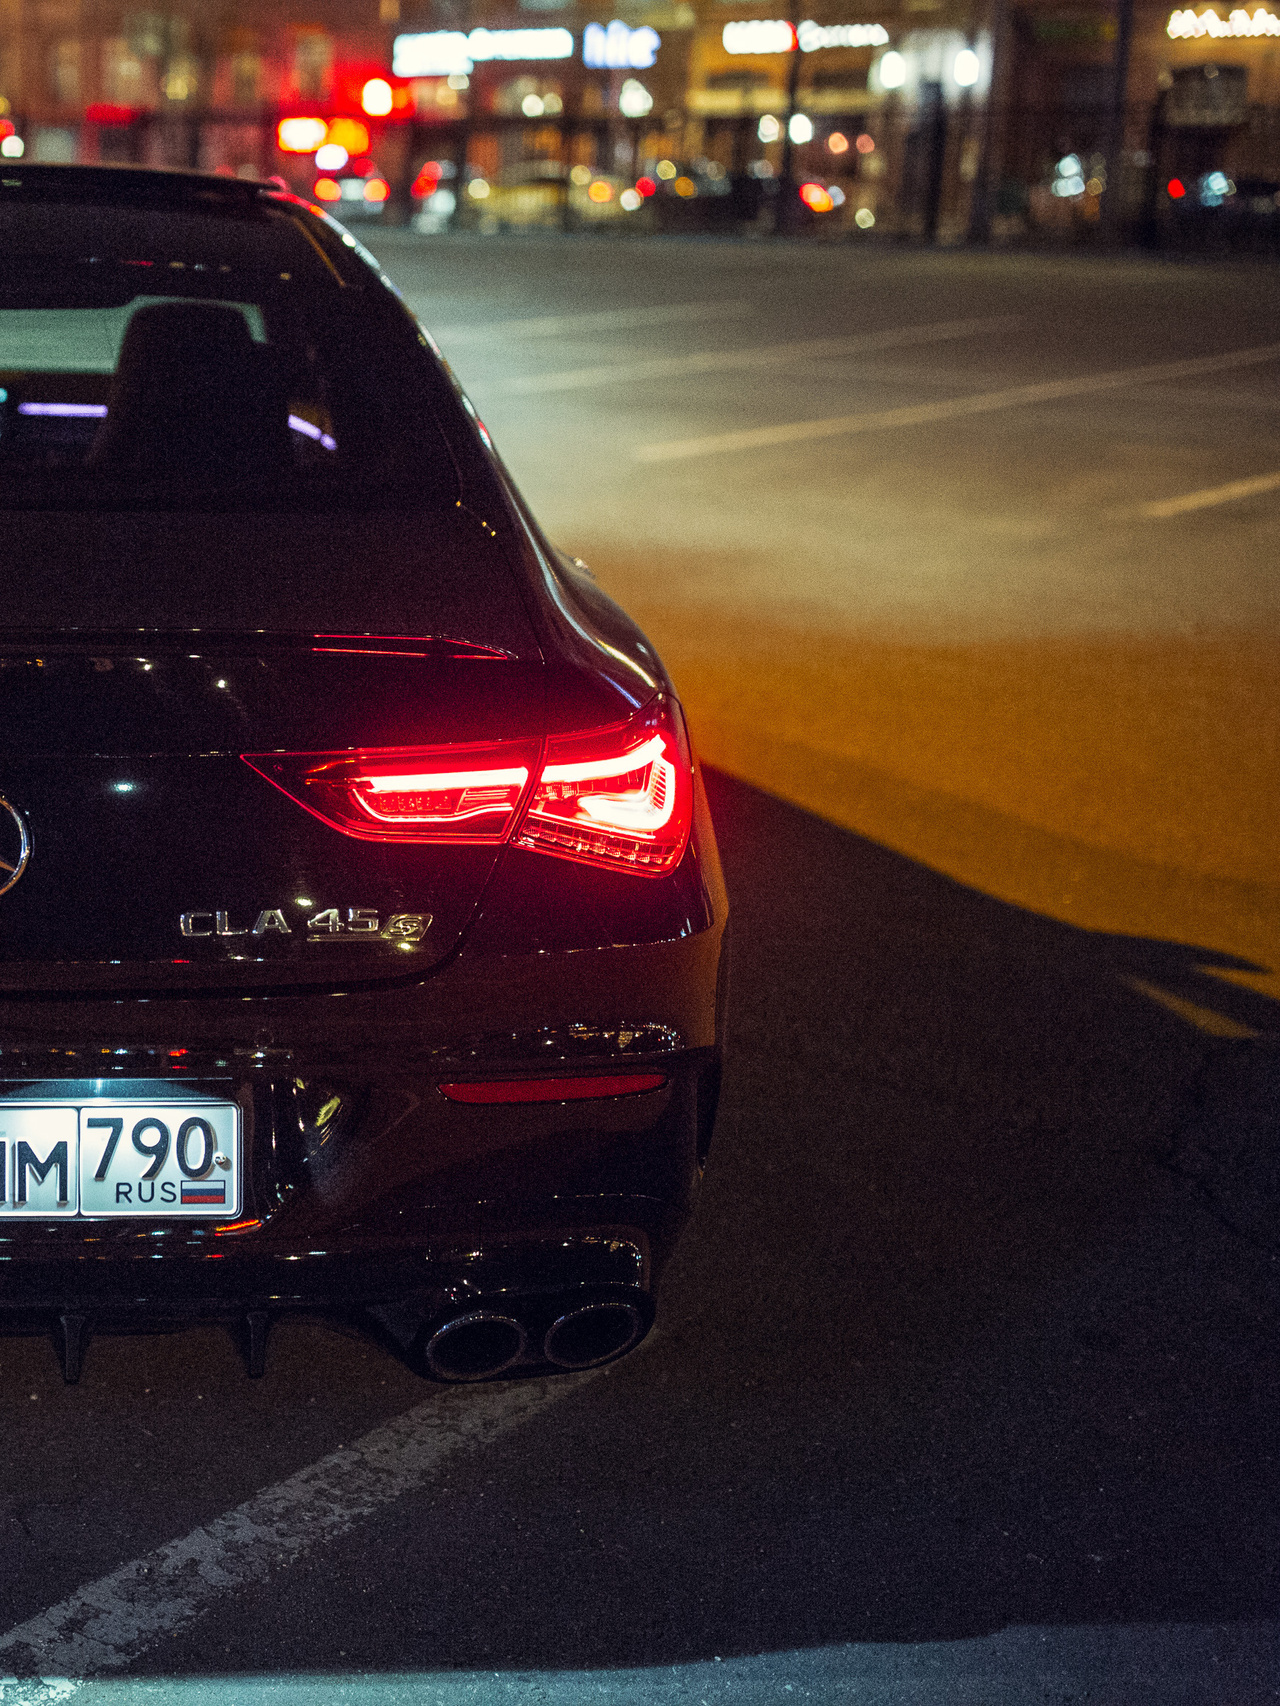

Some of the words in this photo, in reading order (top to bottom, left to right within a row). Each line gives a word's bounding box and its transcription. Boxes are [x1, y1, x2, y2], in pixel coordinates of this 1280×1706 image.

[180, 909, 292, 936] CLA
[86, 1117, 214, 1181] 790
[115, 1182, 177, 1203] RUS
